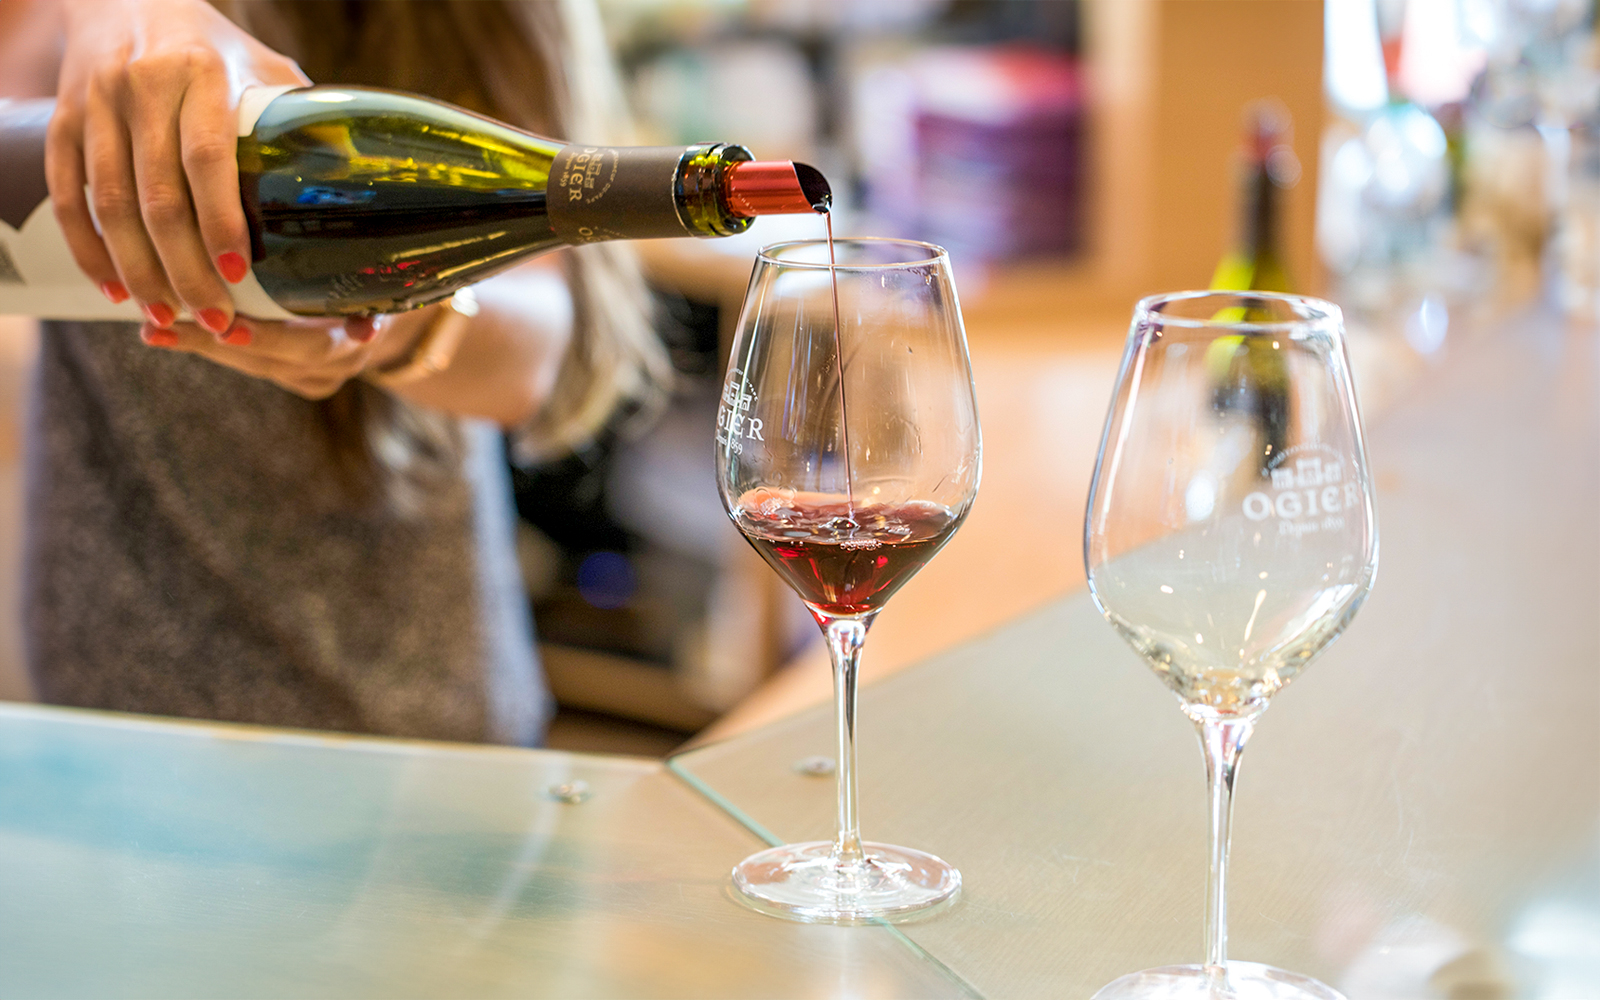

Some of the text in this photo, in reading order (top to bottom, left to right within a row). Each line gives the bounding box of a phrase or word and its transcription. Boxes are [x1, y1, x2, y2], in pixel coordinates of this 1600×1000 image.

[569, 148, 599, 202] OGIER
[717, 405, 765, 441] GIER
[730, 439, 743, 456] 859
[1242, 481, 1359, 521] OGIER
